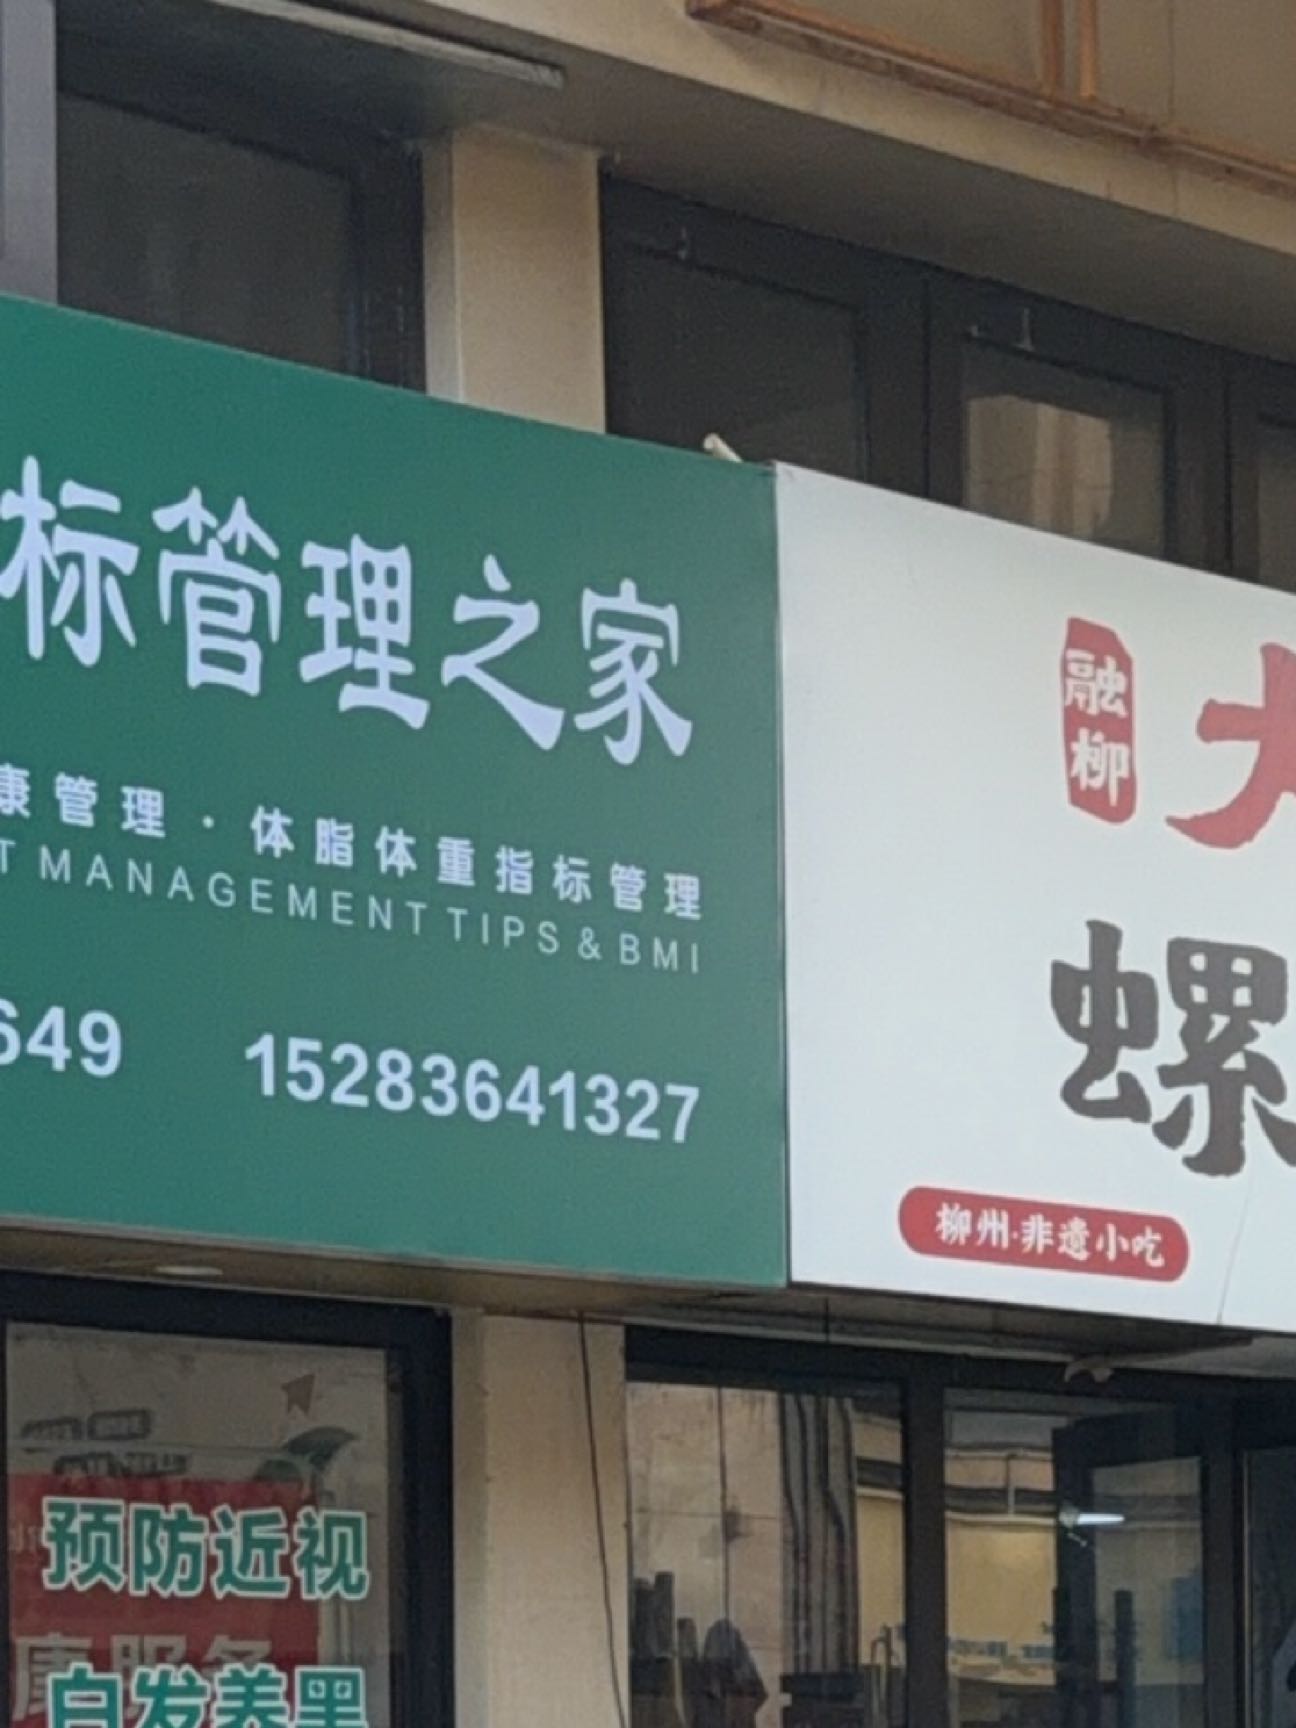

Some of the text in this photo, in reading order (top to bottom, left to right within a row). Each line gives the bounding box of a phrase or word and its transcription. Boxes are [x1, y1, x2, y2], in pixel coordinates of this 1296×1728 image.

[0, 455, 694, 765] 标管理之家
[1064, 650, 1133, 802] 融柳
[38, 844, 428, 937] MANAGEMENT
[244, 1032, 701, 1143] 15283641327
[43, 1495, 370, 1600] 预防近视
